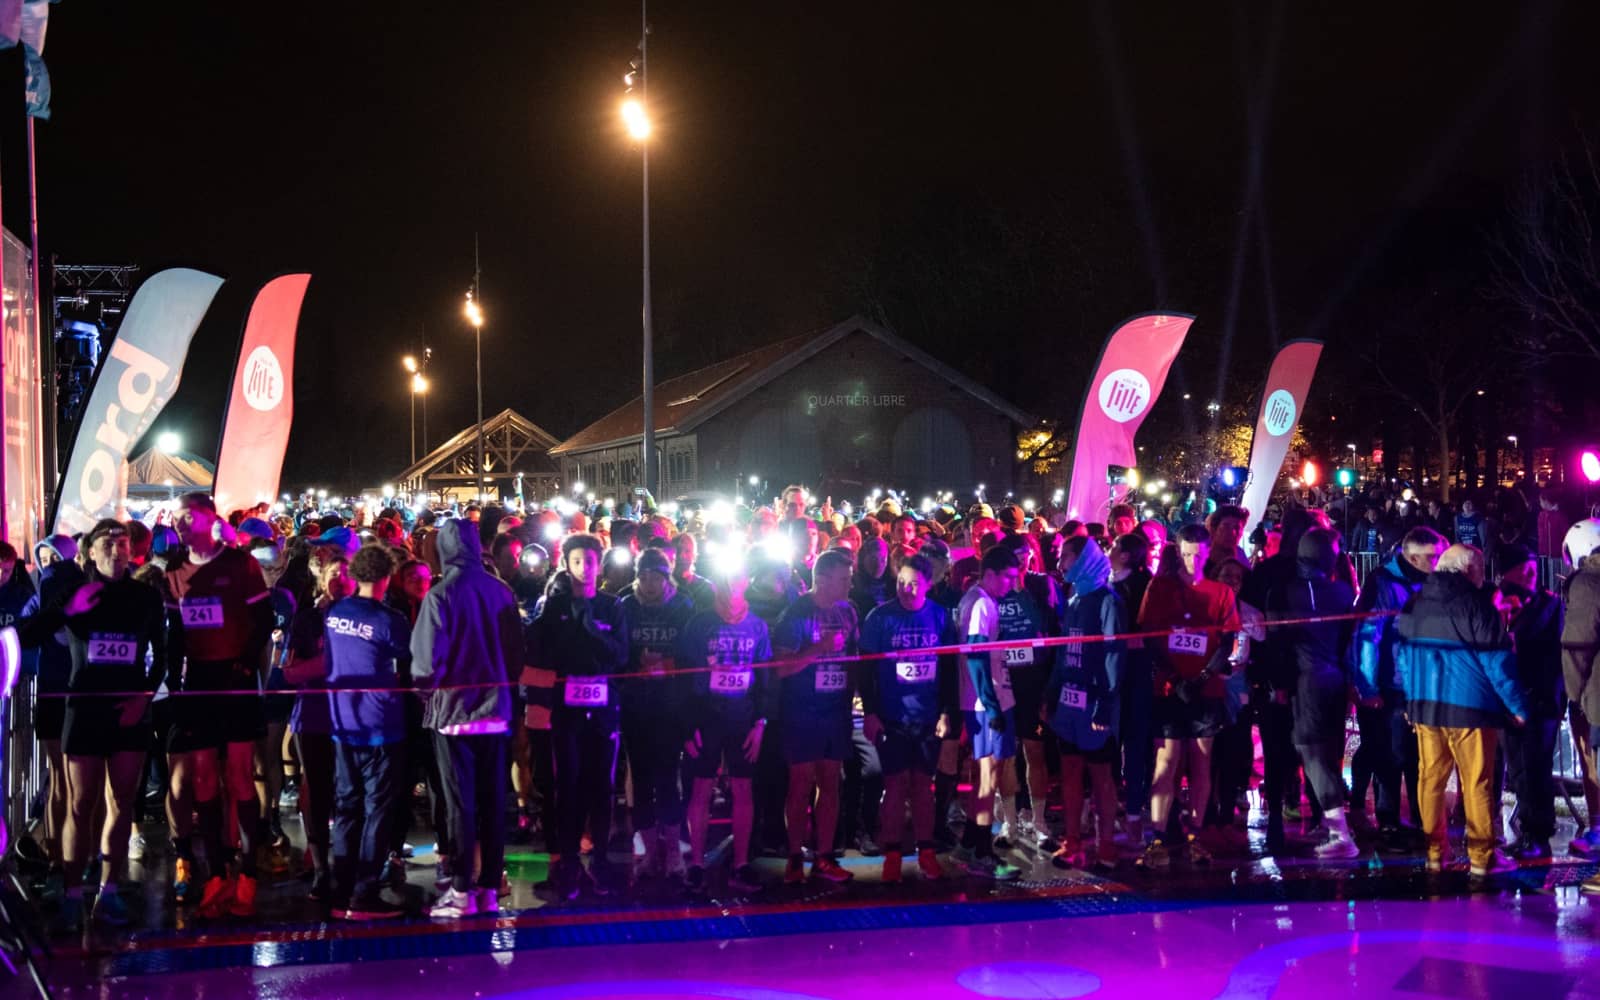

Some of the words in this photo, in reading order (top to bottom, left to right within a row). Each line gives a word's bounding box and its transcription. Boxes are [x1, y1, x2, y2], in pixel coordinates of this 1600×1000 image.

[807, 394, 870, 407] QUARTIER
[873, 394, 905, 407] LIBRE
[189, 607, 213, 622] 241
[1175, 635, 1201, 649] 236
[97, 643, 129, 657] 240
[1004, 649, 1026, 661] 316
[905, 665, 931, 678] 237
[718, 674, 745, 687] 295
[823, 674, 845, 687] 299
[571, 686, 601, 699] 286
